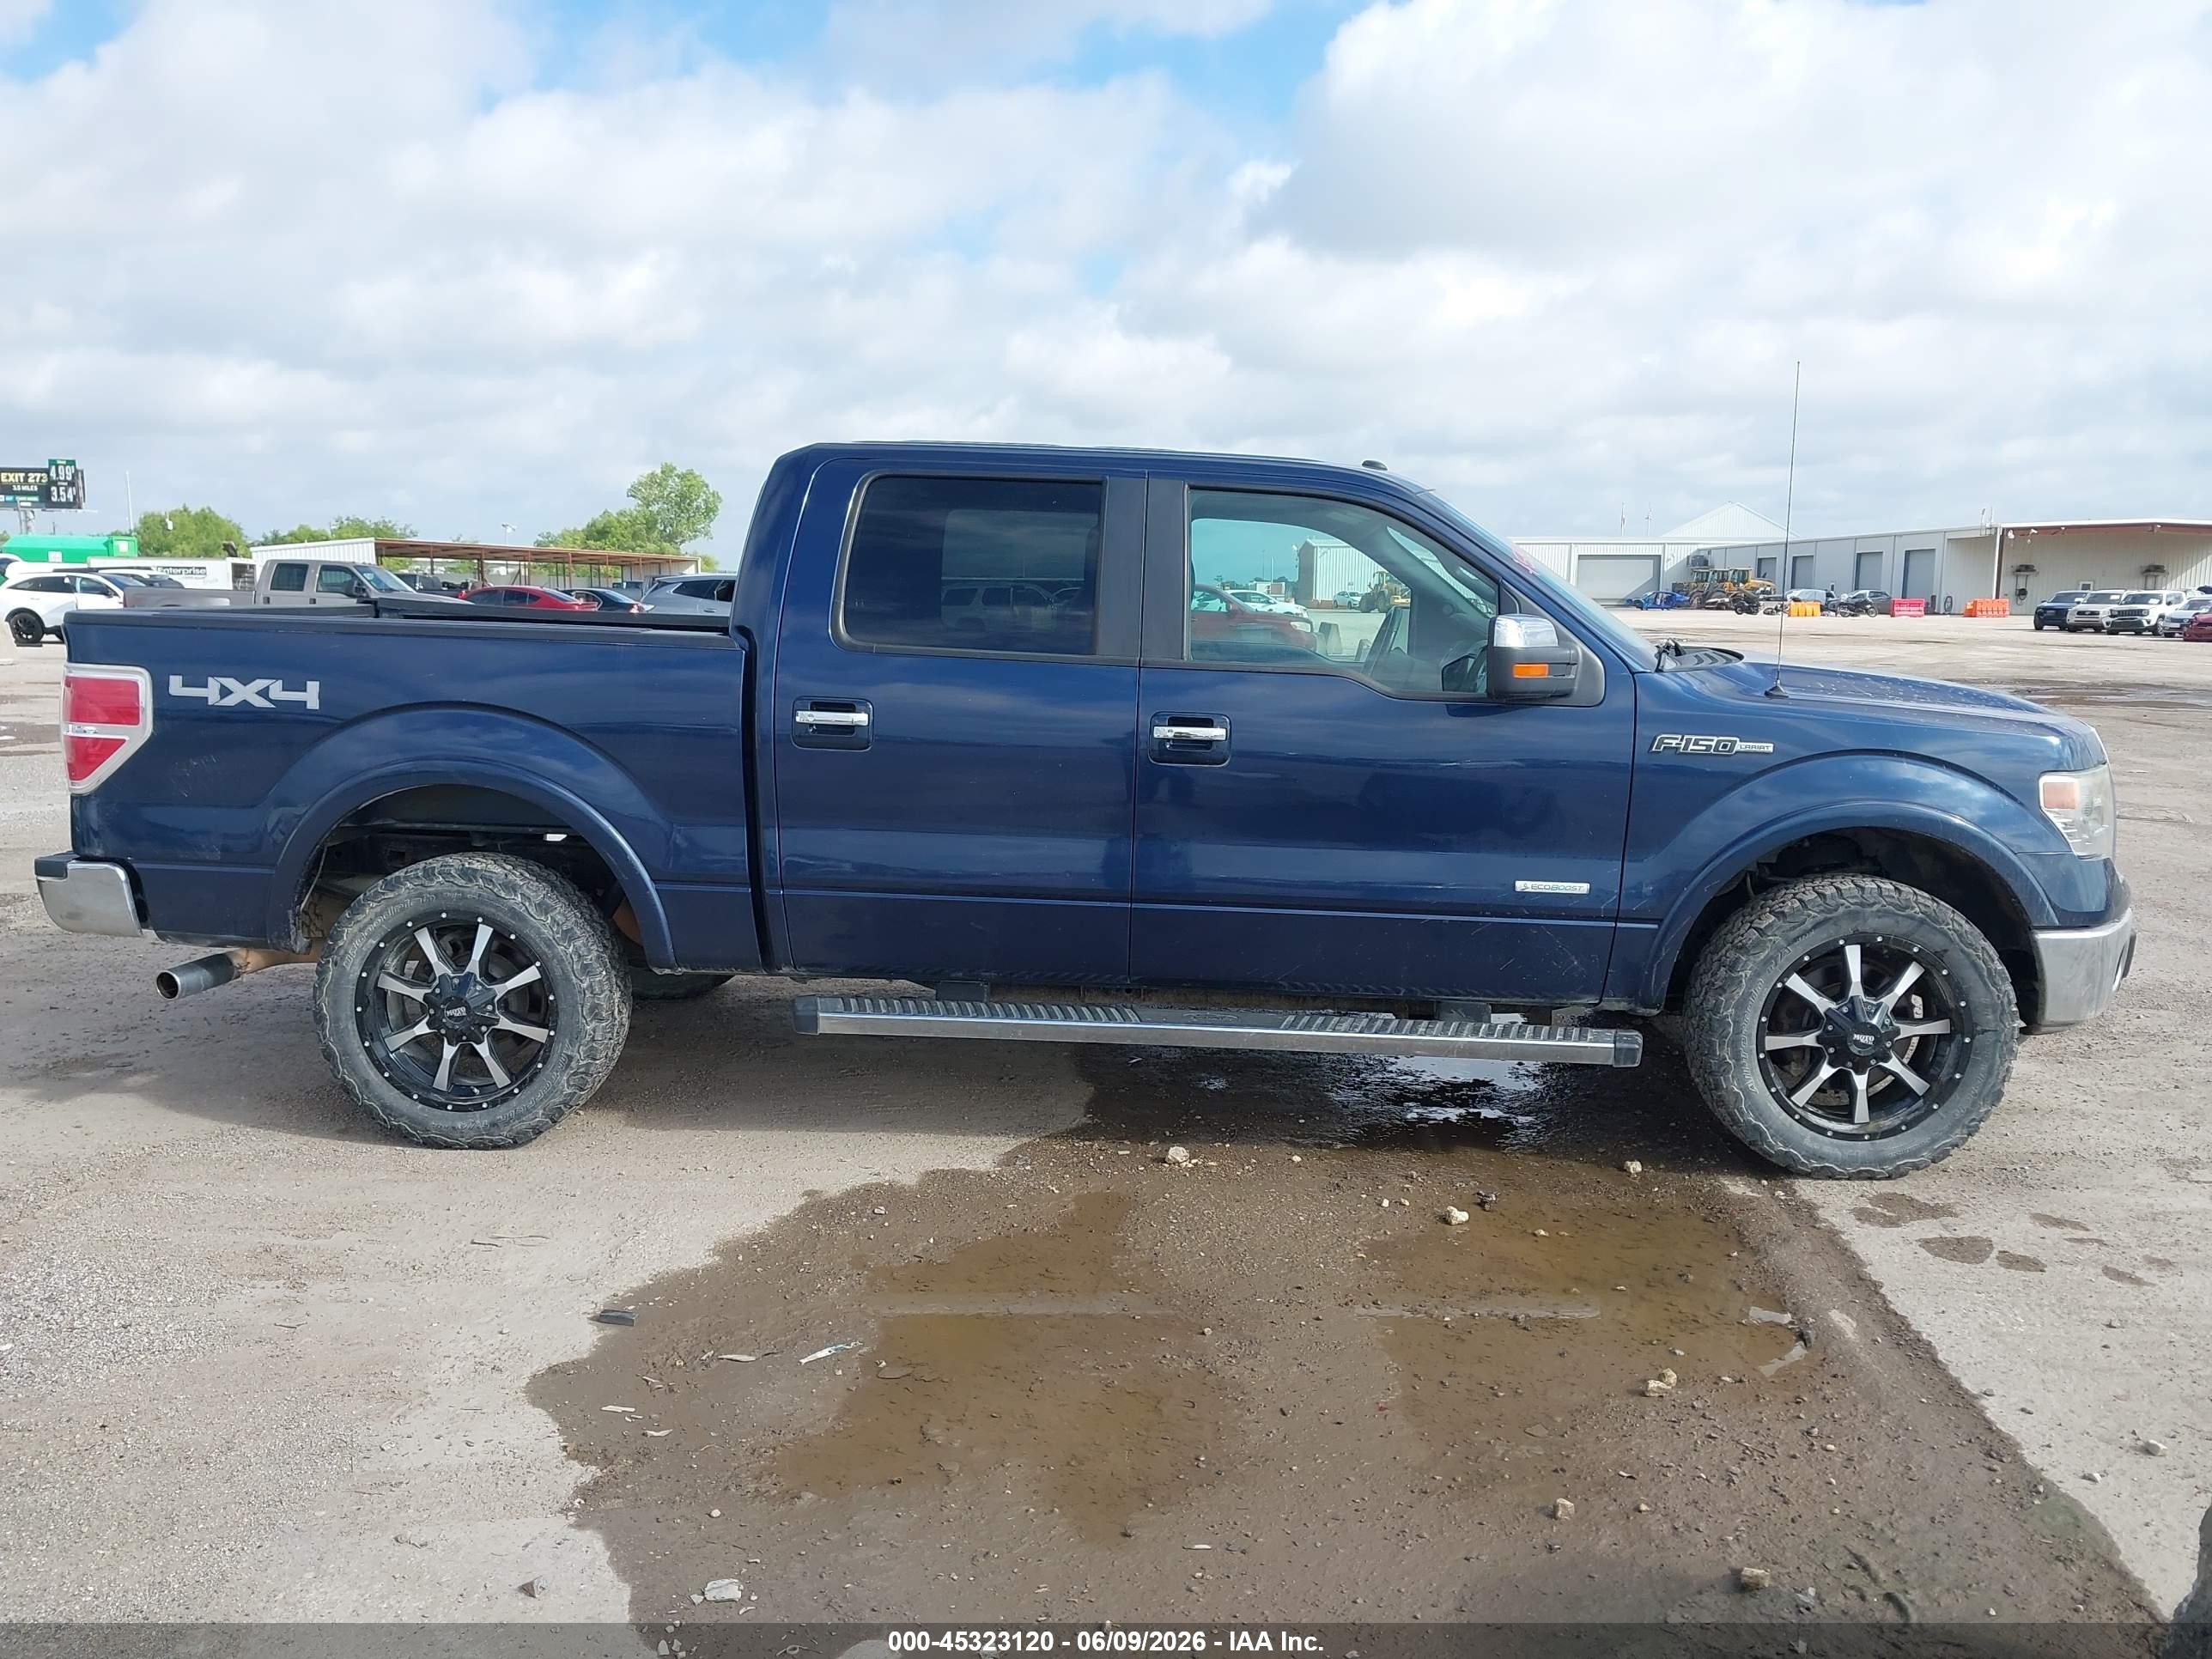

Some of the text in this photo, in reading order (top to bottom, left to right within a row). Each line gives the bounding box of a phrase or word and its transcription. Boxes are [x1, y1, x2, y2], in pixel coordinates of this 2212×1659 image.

[1, 472, 48, 483] EXIT 273
[157, 566, 206, 576] Enterprise
[1649, 733, 1741, 756] F-150
[1853, 1033, 1875, 1042] MOTO
